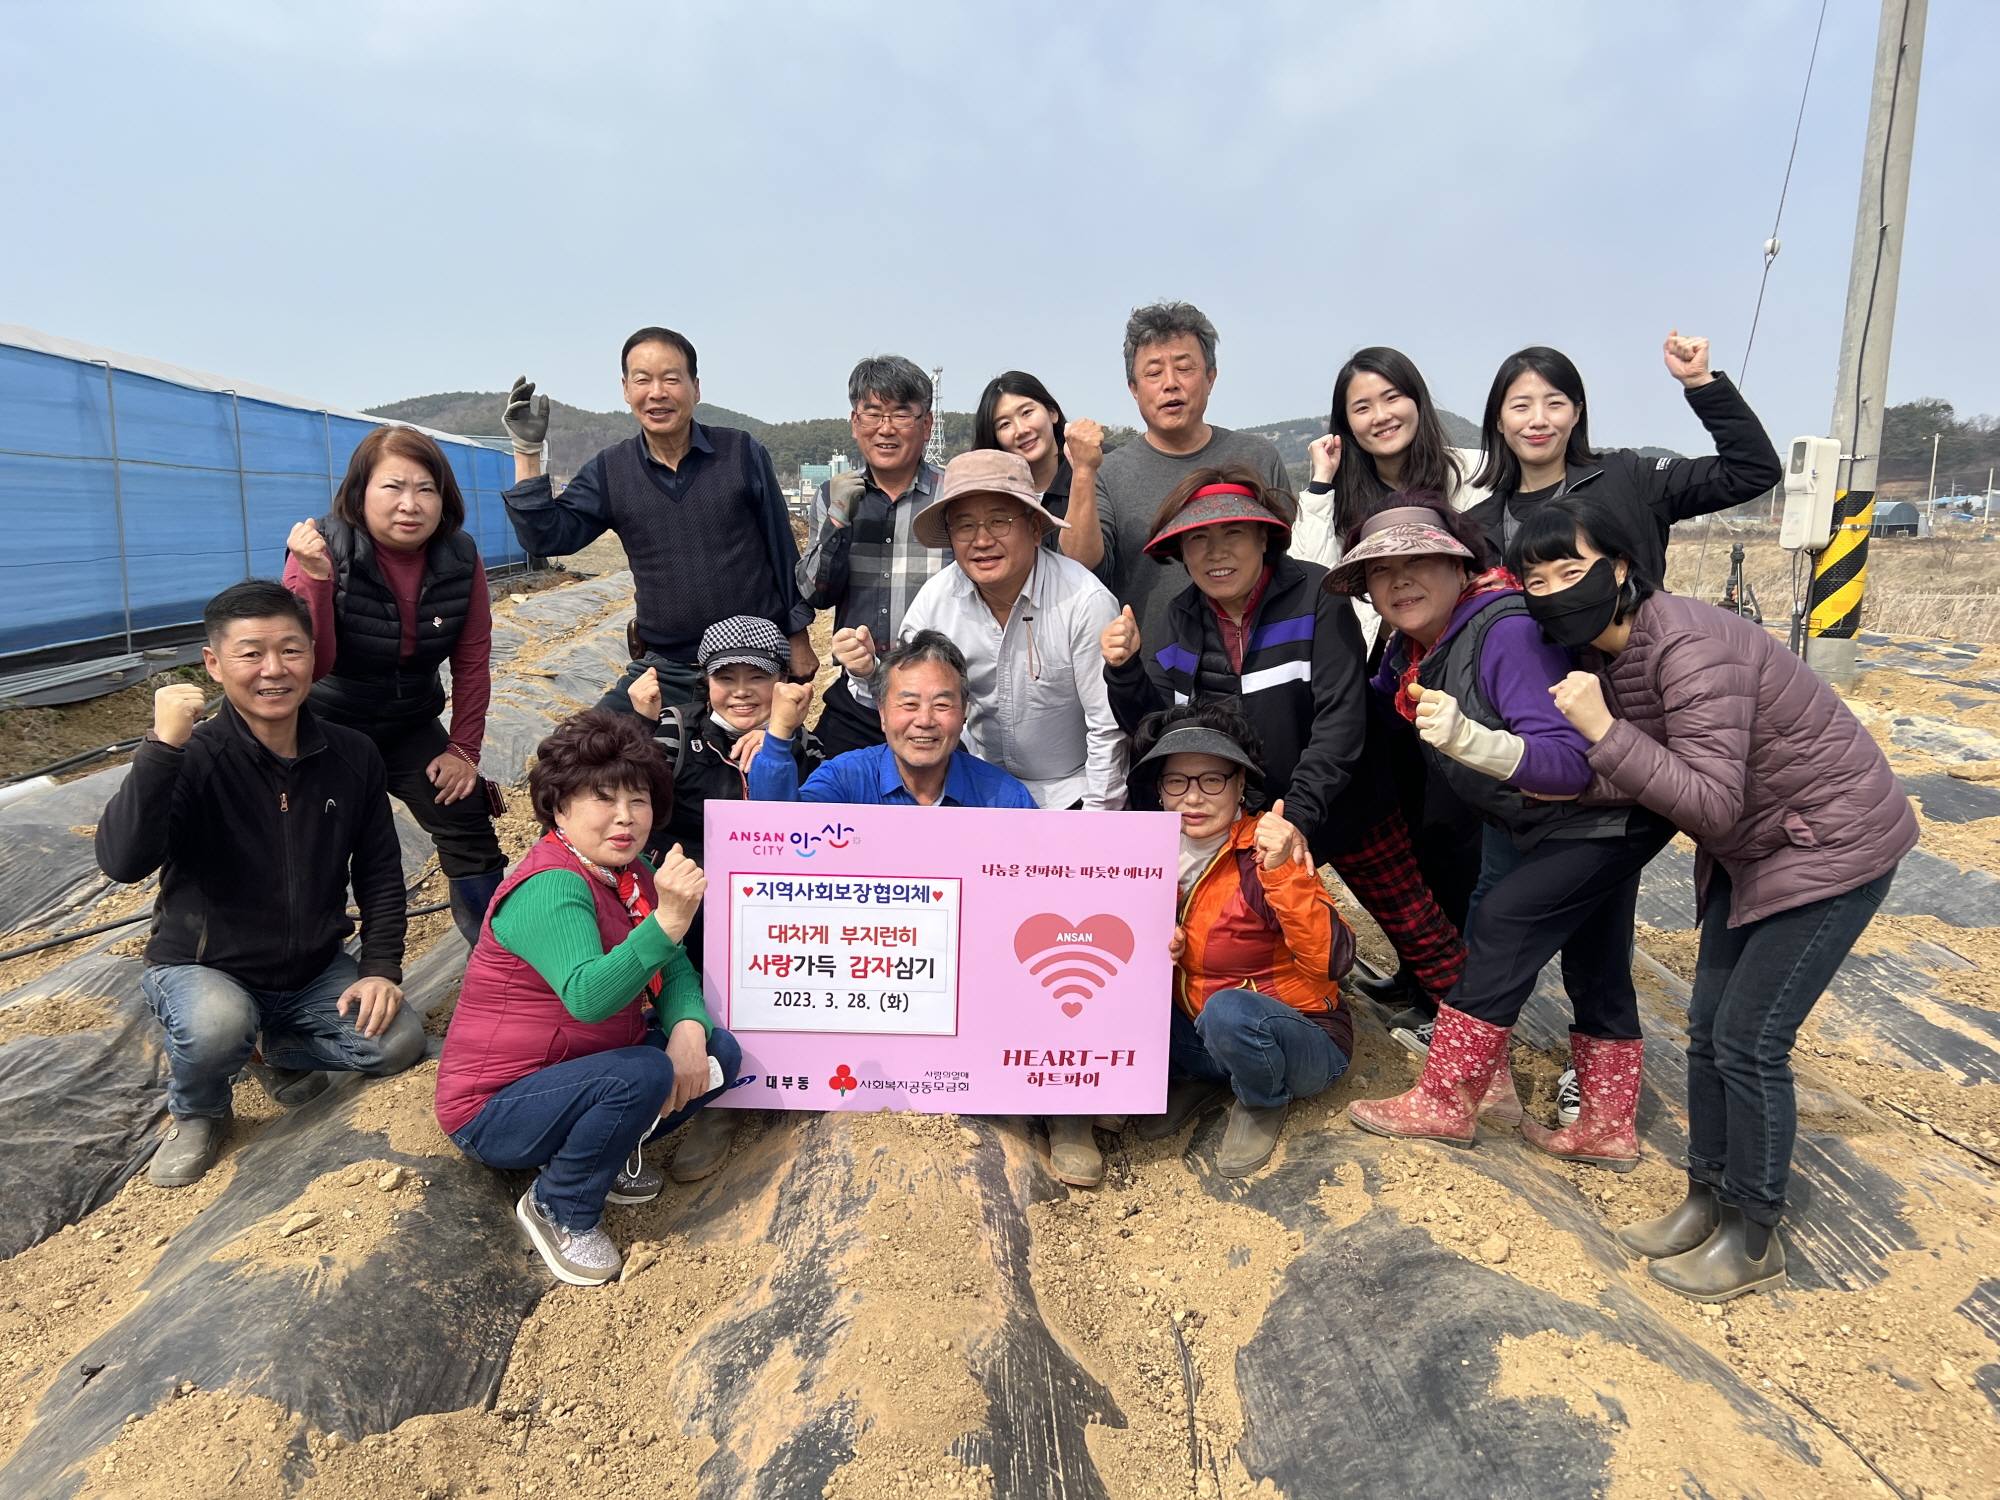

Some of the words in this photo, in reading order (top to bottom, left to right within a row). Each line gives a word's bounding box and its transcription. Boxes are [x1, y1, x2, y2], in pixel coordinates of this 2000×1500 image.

[729, 831, 785, 842] ANSAN
[790, 823, 854, 857] 안산
[753, 845, 784, 856] CITY
[981, 864, 1021, 878] 나눔을
[1024, 865, 1077, 879] 전파하는
[1080, 866, 1121, 879] 따듯한
[1123, 866, 1163, 880] 에너지
[756, 881, 930, 904] 지역사회보장협의체
[768, 924, 829, 945] 대차게
[840, 925, 918, 947] 부지런히
[1056, 932, 1093, 943] ANSAN
[748, 954, 837, 979] 사랑가득
[850, 955, 935, 980] 감자심기
[773, 991, 816, 1009] 2023.
[825, 992, 839, 1009] 3.
[847, 993, 871, 1010] 28.
[880, 992, 910, 1013] (화)
[1003, 1049, 1137, 1067] HEART-FI
[924, 1070, 970, 1081] 사랑의열매
[1027, 1072, 1100, 1088] 하트파이
[859, 1079, 970, 1094] 사회복지공동모금회
